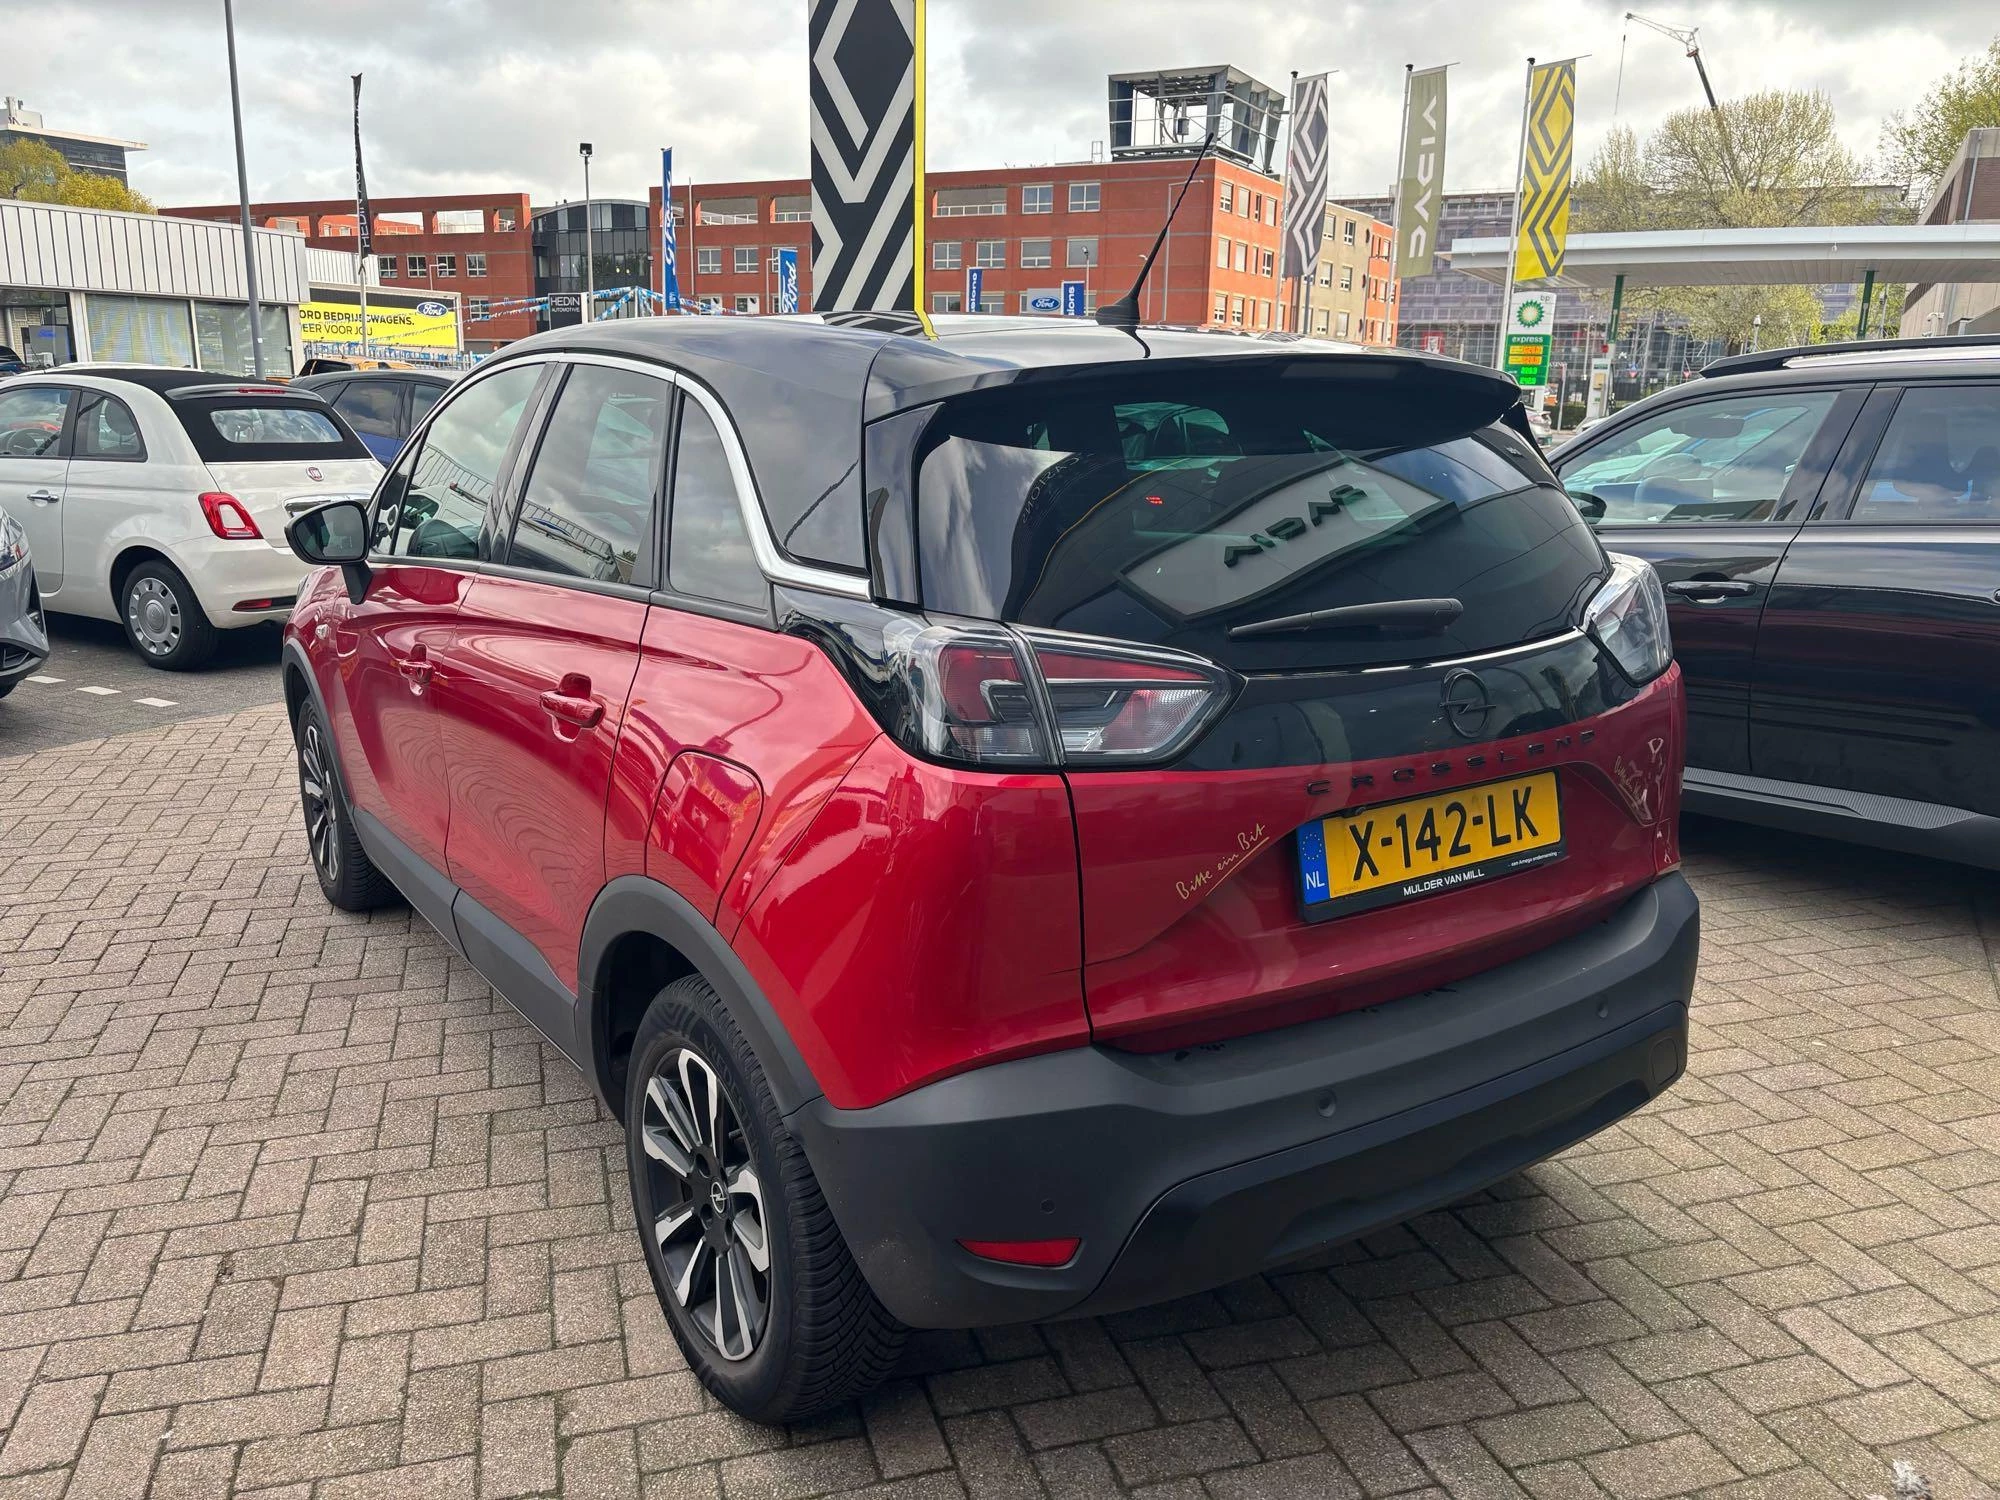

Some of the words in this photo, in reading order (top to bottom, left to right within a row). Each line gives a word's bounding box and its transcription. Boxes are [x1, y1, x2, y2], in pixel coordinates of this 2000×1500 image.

[1408, 95, 1437, 258] DACIA
[551, 296, 580, 306] HEDIN
[781, 260, 798, 313] Ford
[301, 323, 322, 333] EER
[324, 324, 353, 335] VOOR
[1306, 729, 1596, 796] CROSSLAND
[1217, 853, 1239, 871] ein
[1237, 823, 1266, 850] Bit
[1349, 786, 1540, 882] X-142-LK
[1305, 870, 1325, 890] NL
[1403, 878, 1443, 896] MULDER
[1444, 873, 1462, 885] VAN
[1462, 868, 1485, 881] MILL
